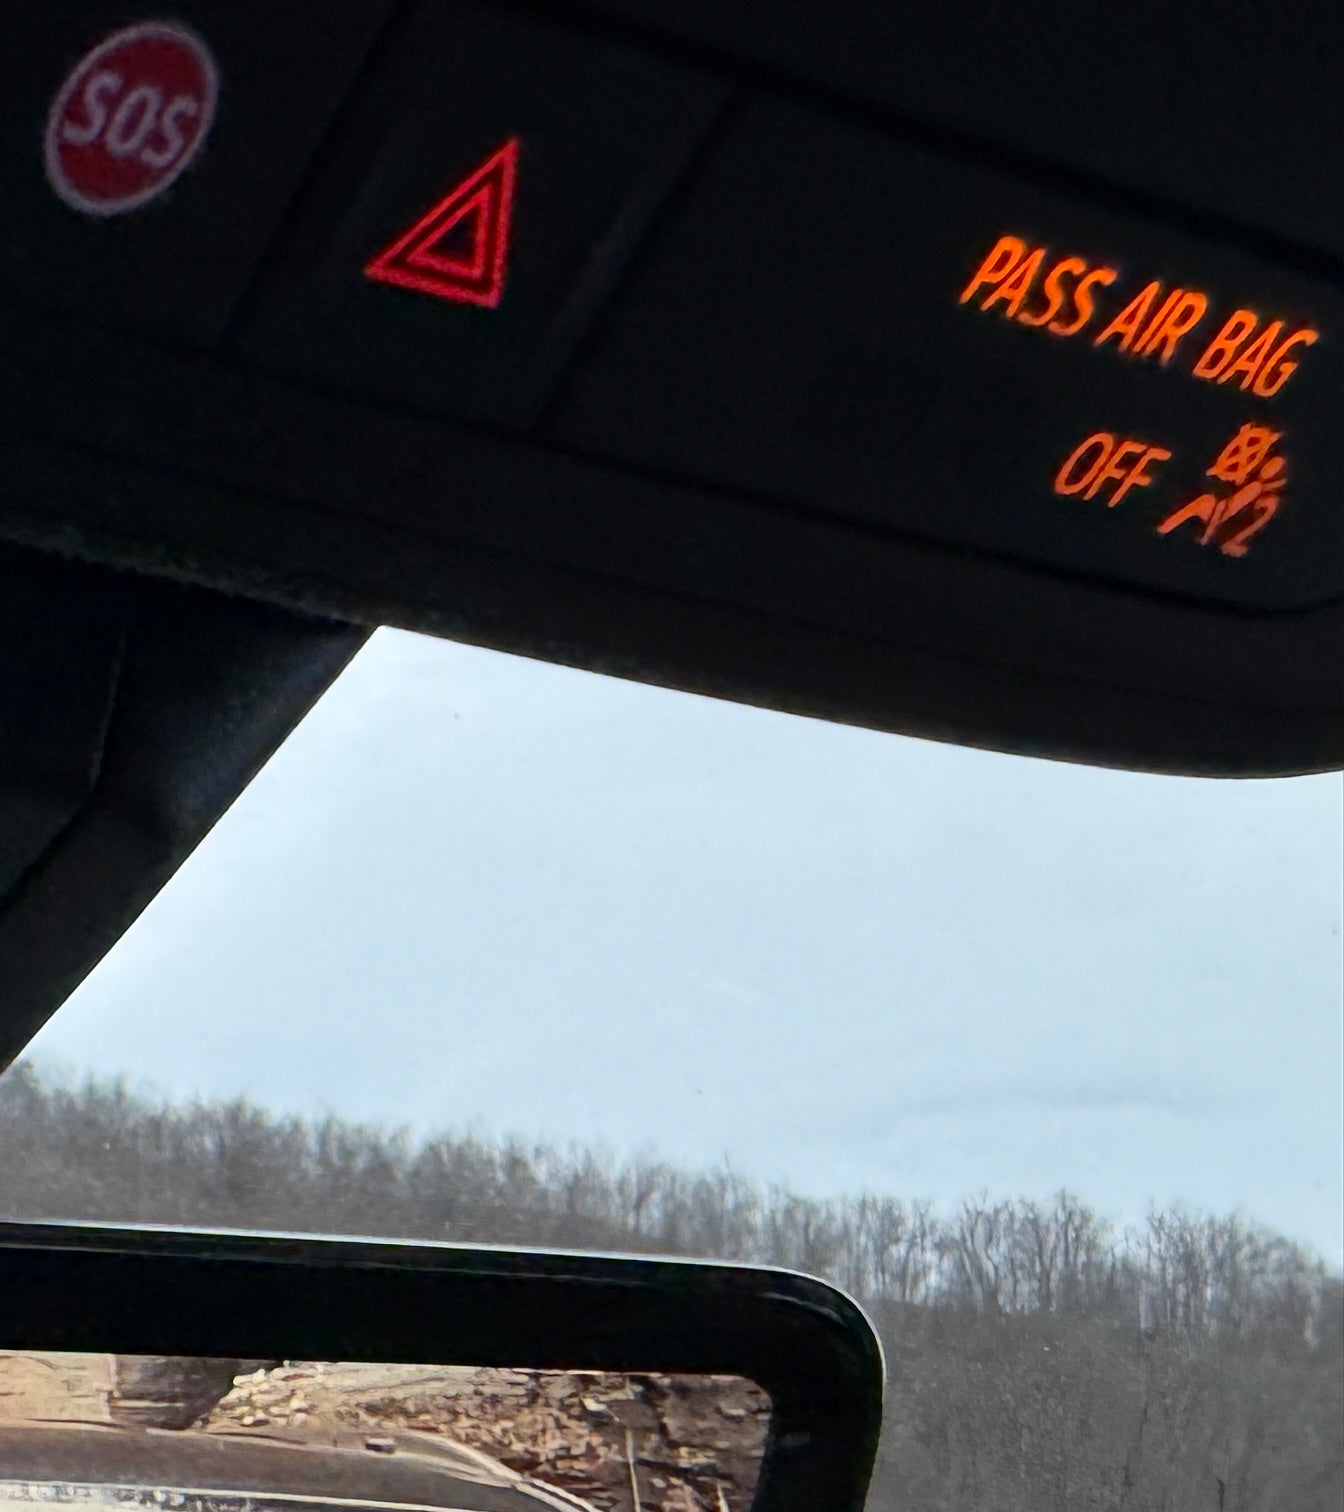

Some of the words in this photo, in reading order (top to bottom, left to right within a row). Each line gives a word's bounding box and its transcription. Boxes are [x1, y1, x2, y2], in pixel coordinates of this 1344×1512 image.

[61, 70, 200, 168] SOS
[960, 235, 1117, 336] PASS
[1095, 280, 1208, 366] AIR
[1193, 309, 1319, 398] BAG
[1053, 432, 1172, 508] OFF
